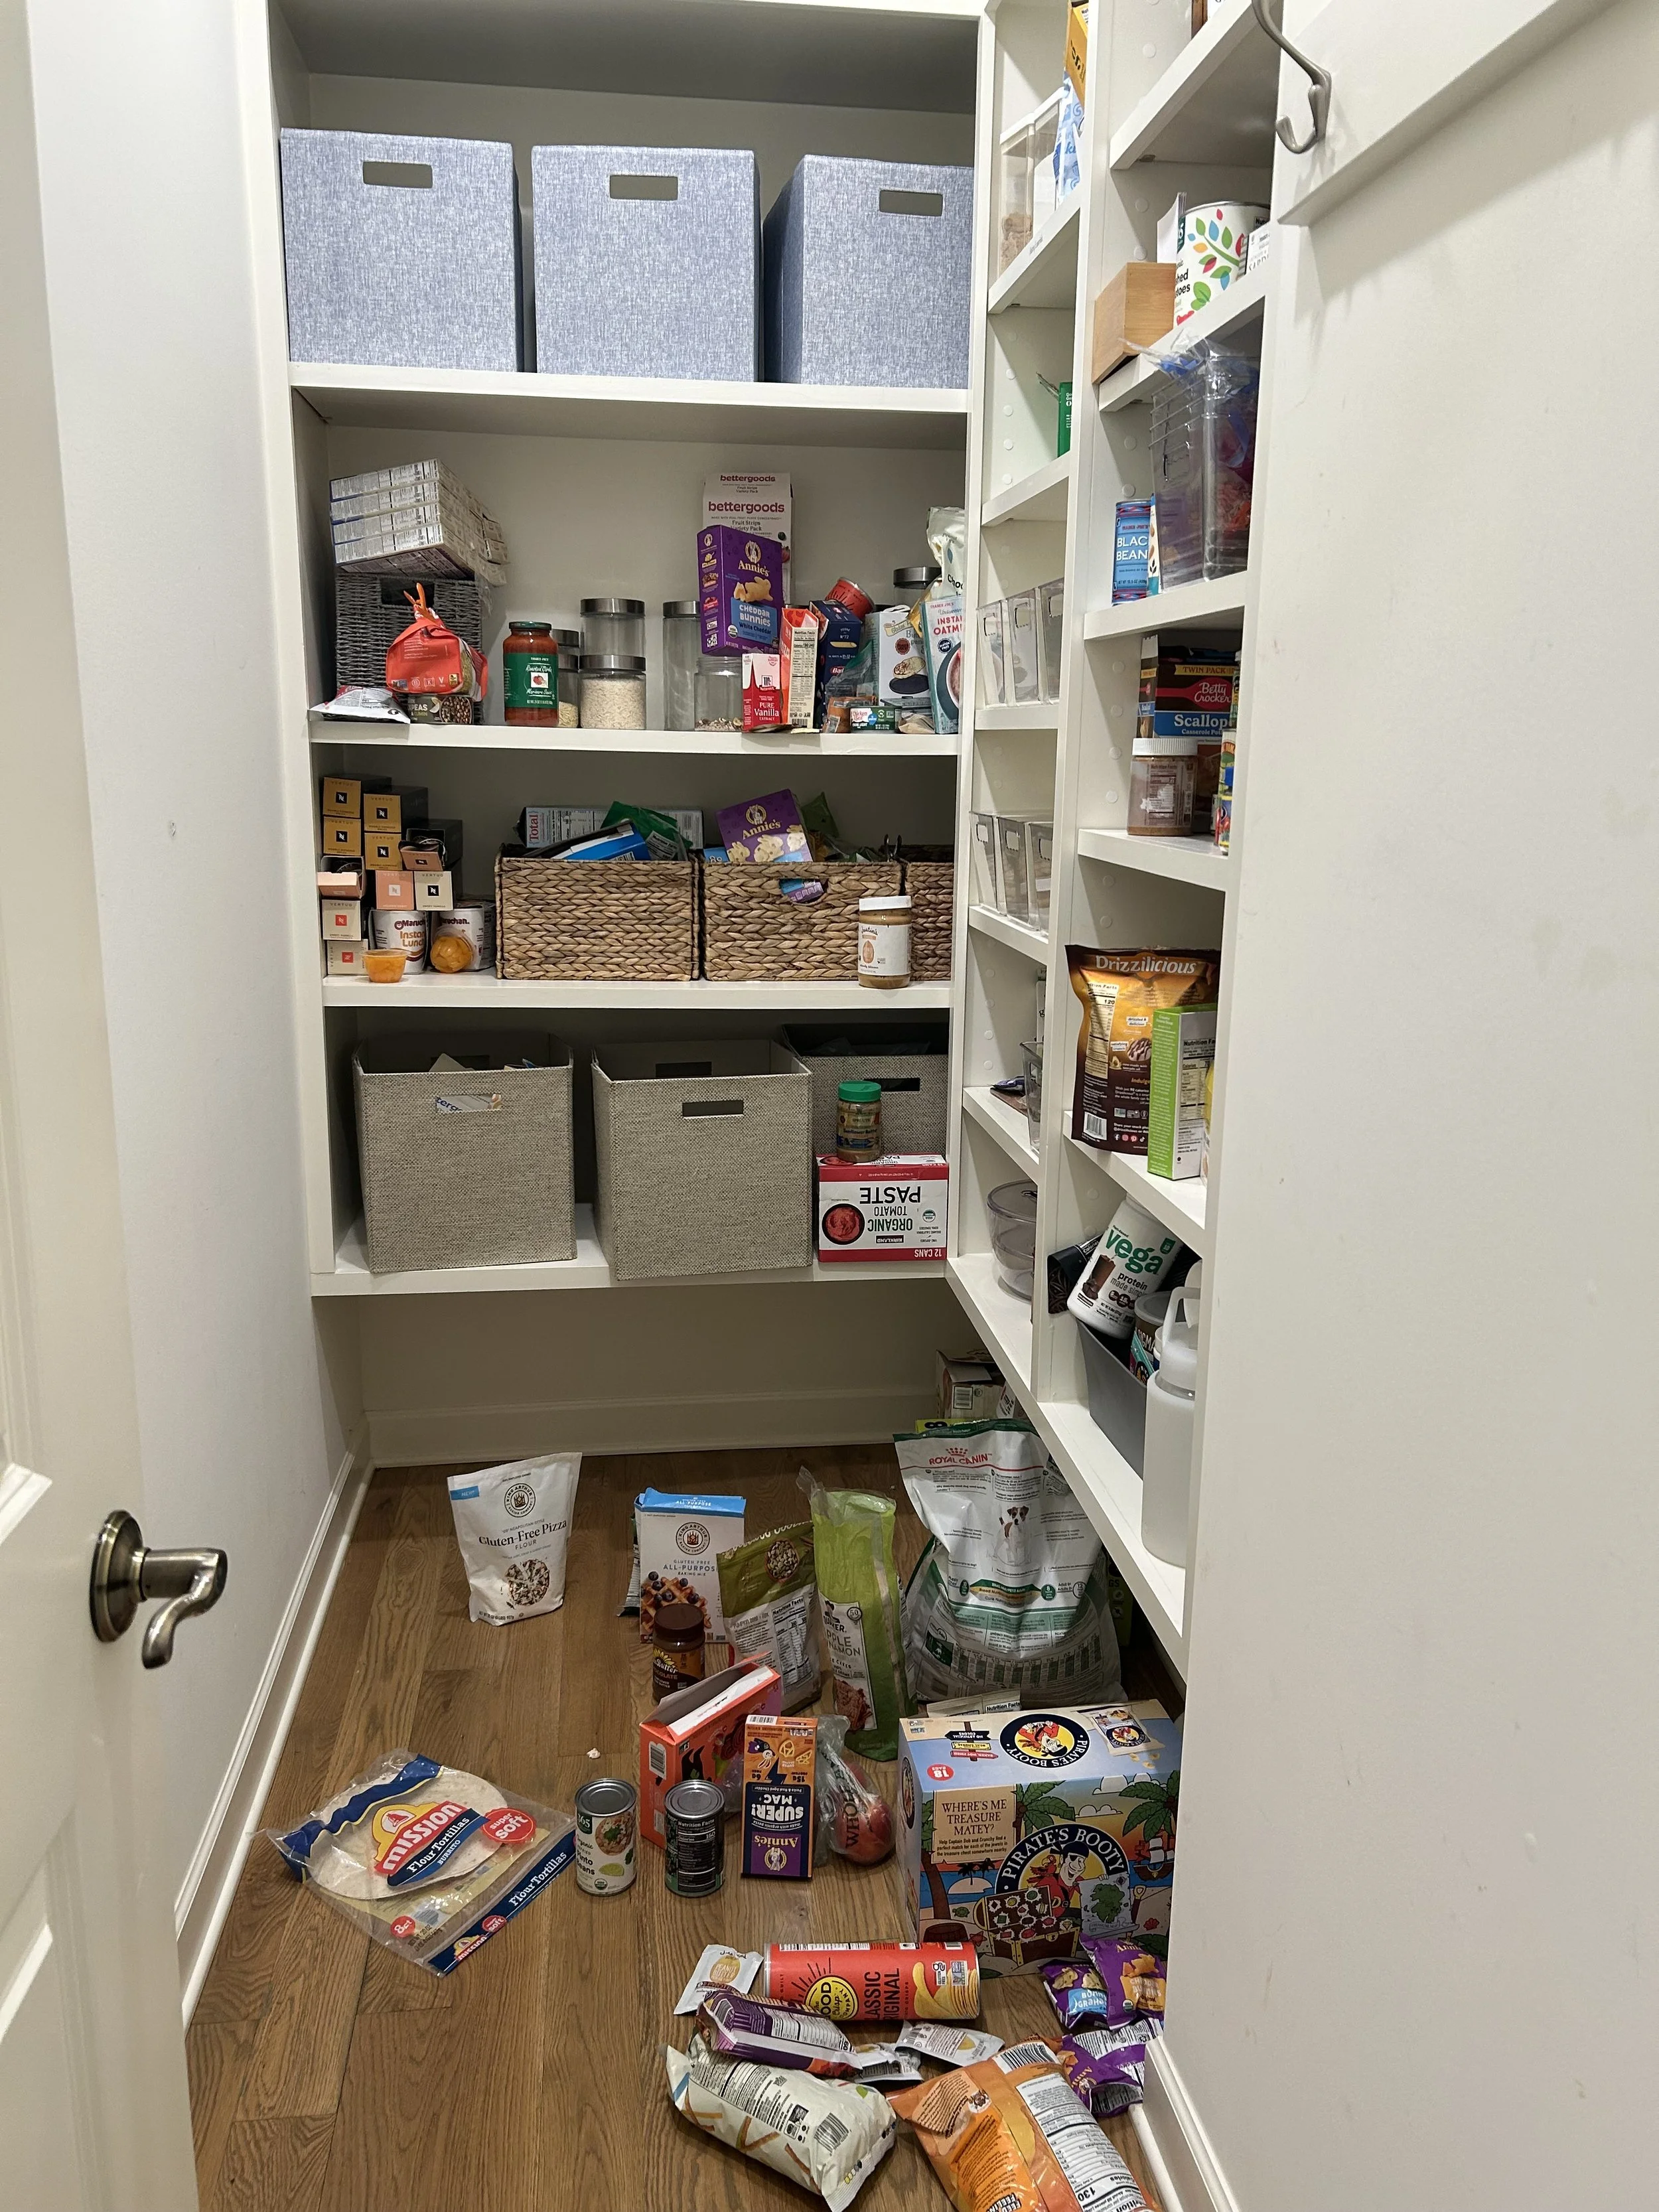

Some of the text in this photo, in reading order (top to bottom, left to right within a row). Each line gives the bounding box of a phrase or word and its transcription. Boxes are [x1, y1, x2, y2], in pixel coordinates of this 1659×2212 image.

[720, 475, 776, 483] bettergoods
[708, 501, 785, 514] bettergoods
[1117, 536, 1149, 548] BLAC
[1116, 549, 1149, 561] BEAN
[737, 559, 770, 577] Annie's
[937, 615, 962, 625] INSTA
[933, 624, 962, 635] OATM
[1198, 682, 1227, 696] Betty
[1194, 692, 1231, 703] Crocker
[754, 708, 780, 717] Vanilla
[1174, 714, 1231, 732] Scallop
[530, 814, 539, 842] Total
[742, 818, 782, 840] Annie's
[402, 919, 425, 928] Maruch
[1095, 954, 1196, 974] Drizzilicious
[859, 1186, 921, 1205] PASTE
[874, 1205, 908, 1217] TOMATO
[867, 1218, 913, 1232] ORGANIC
[914, 1249, 933, 1258] CANS
[1106, 1228, 1163, 1275] vega
[1110, 1278, 1146, 1298] made simpl
[1118, 1272, 1148, 1291] protein
[929, 1453, 988, 1465] ROYAL CANIN
[514, 1485, 532, 1497] ARTHUR
[478, 1519, 567, 1546] Gluten-Free Pizza
[679, 1524, 708, 1538] KING ARTHUR
[515, 1539, 537, 1550] FLOUR
[663, 1564, 716, 1572] ALL-PURPOS
[826, 1629, 852, 1647] PPLE
[1006, 1739, 1088, 1767] PIRATE'S BOOTY
[933, 1769, 950, 1778] 18
[763, 1794, 792, 1805] MAC
[942, 1799, 1007, 1813] WHERE'S ME
[751, 1803, 804, 1821] SUPER!
[946, 1811, 1001, 1824] TREASURE
[489, 1812, 513, 1830] super
[494, 1815, 530, 1840] soft
[954, 1823, 995, 1836] MATEY?
[382, 1804, 463, 1871] mission
[406, 1817, 470, 1873] Flour Tortillas
[754, 1835, 799, 1848] Annie's
[437, 1839, 462, 1866] BURRITO
[1001, 1828, 1125, 1880] PIRATE'S BOOTY
[508, 1852, 568, 1907] Flour Tortillas
[394, 1919, 413, 1935] 8ct
[820, 1982, 831, 2019] OOD
[863, 1970, 881, 2020] LASSIC
[883, 1967, 900, 2020] RIGINAL
[1078, 2186, 1096, 2201] 130
